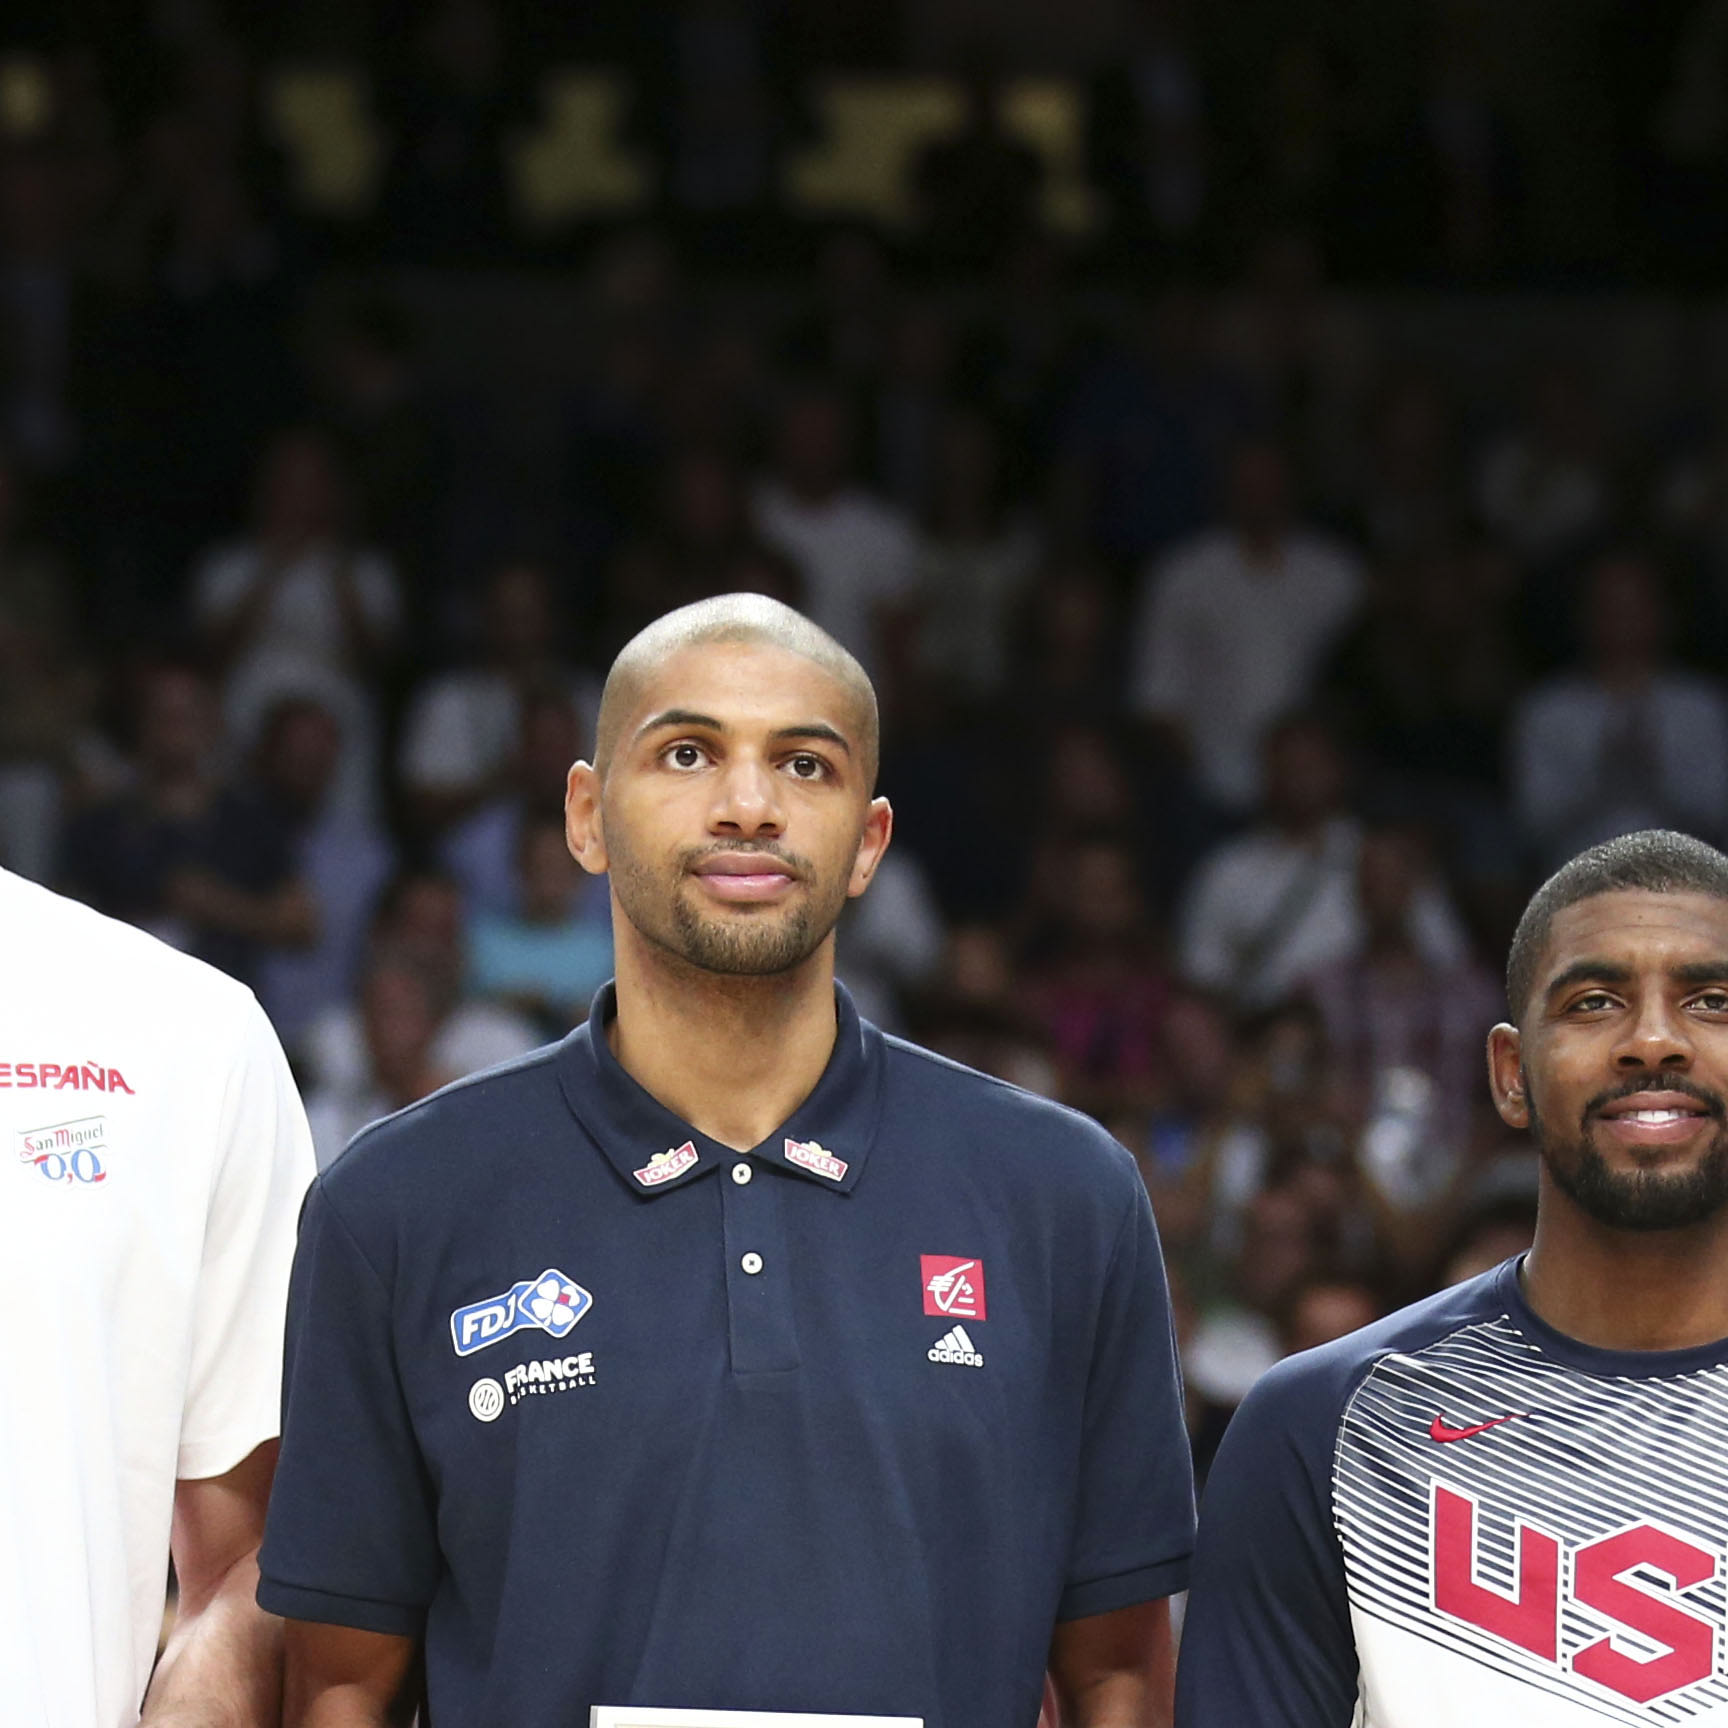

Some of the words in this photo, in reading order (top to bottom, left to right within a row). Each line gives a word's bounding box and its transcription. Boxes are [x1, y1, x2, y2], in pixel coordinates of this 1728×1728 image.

[20, 1136, 54, 1156] San
[54, 1123, 105, 1148] Miguel
[642, 1150, 694, 1184] JOKER
[790, 1144, 841, 1177] JOKER
[462, 1293, 517, 1345] FDJ
[504, 1351, 595, 1394] FRANCE
[927, 1348, 984, 1367] adidas
